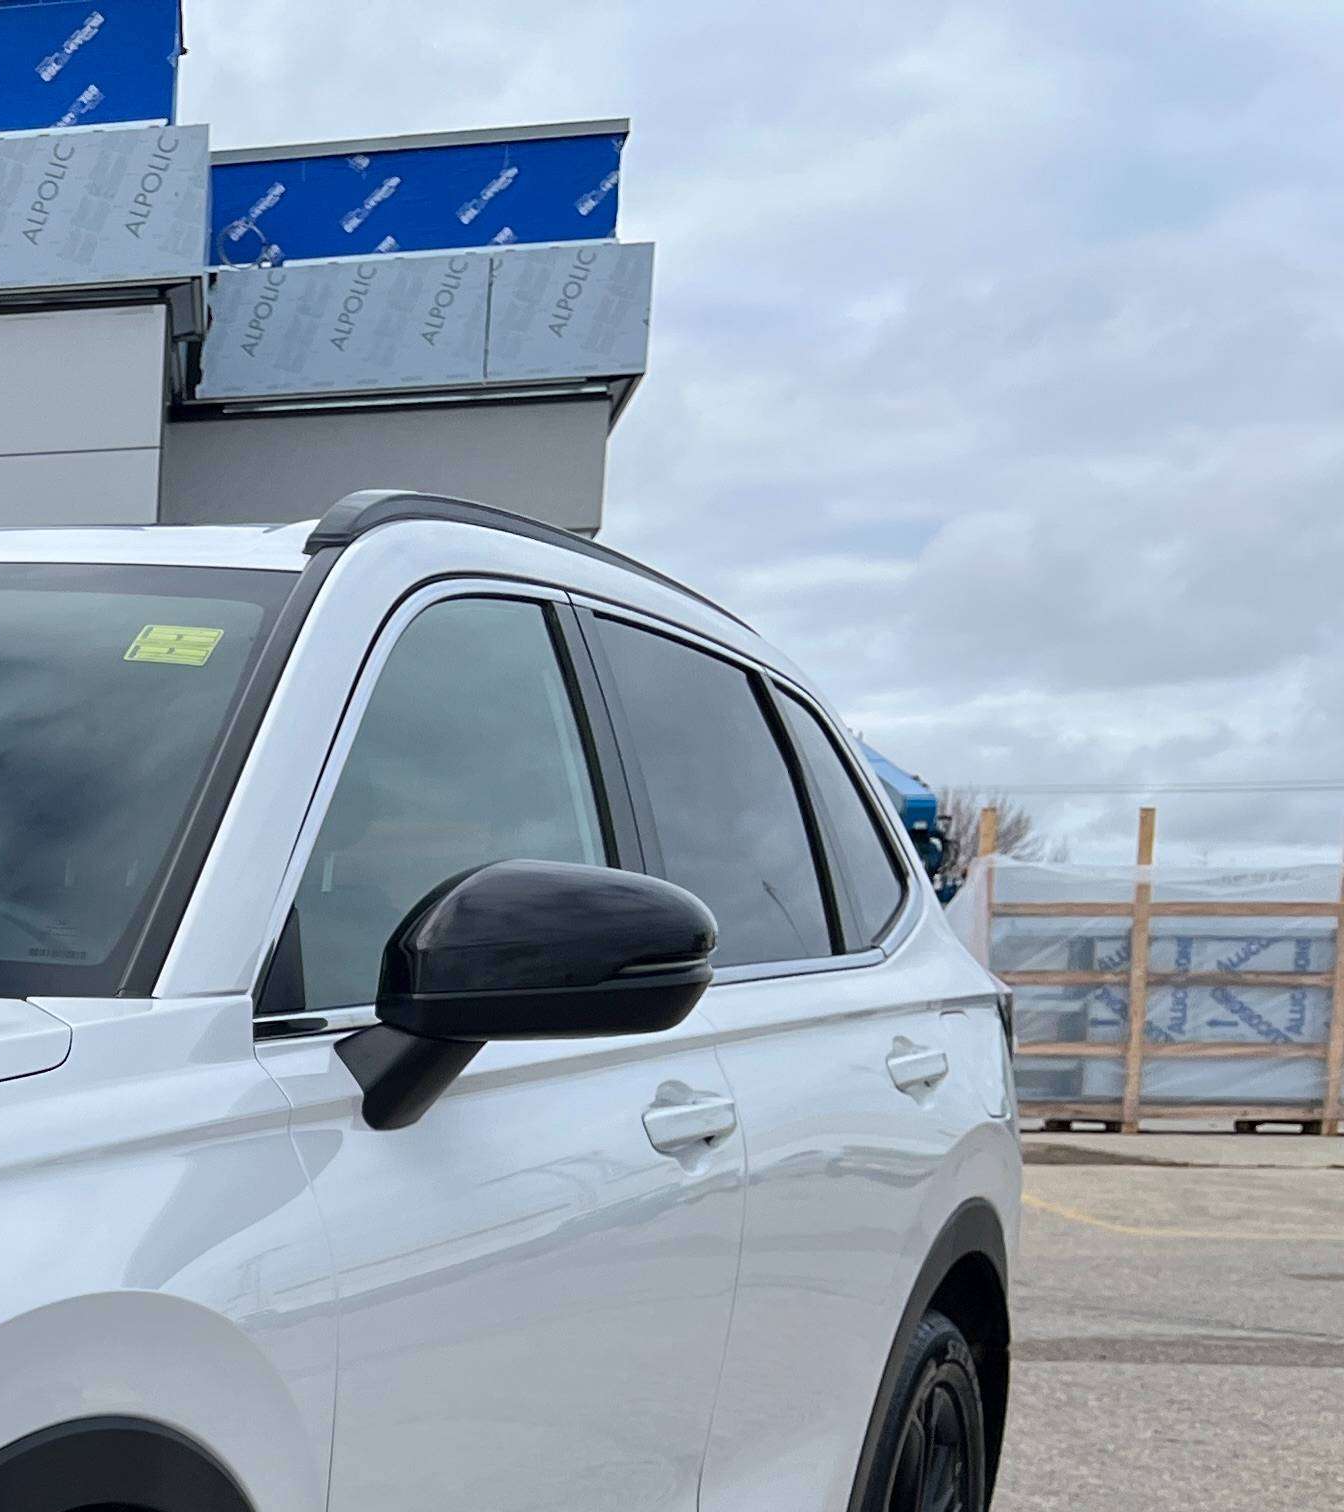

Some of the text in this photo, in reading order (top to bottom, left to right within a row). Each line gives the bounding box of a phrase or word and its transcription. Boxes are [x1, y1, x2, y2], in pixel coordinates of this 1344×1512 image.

[22, 143, 75, 245] ALPOLIC
[125, 134, 179, 238] ALPOLIC
[240, 269, 286, 358] ALPOLIC
[329, 263, 377, 351] ALPOLIC
[420, 258, 469, 347] ALPOLIC
[548, 249, 596, 338] ALPOLIC
